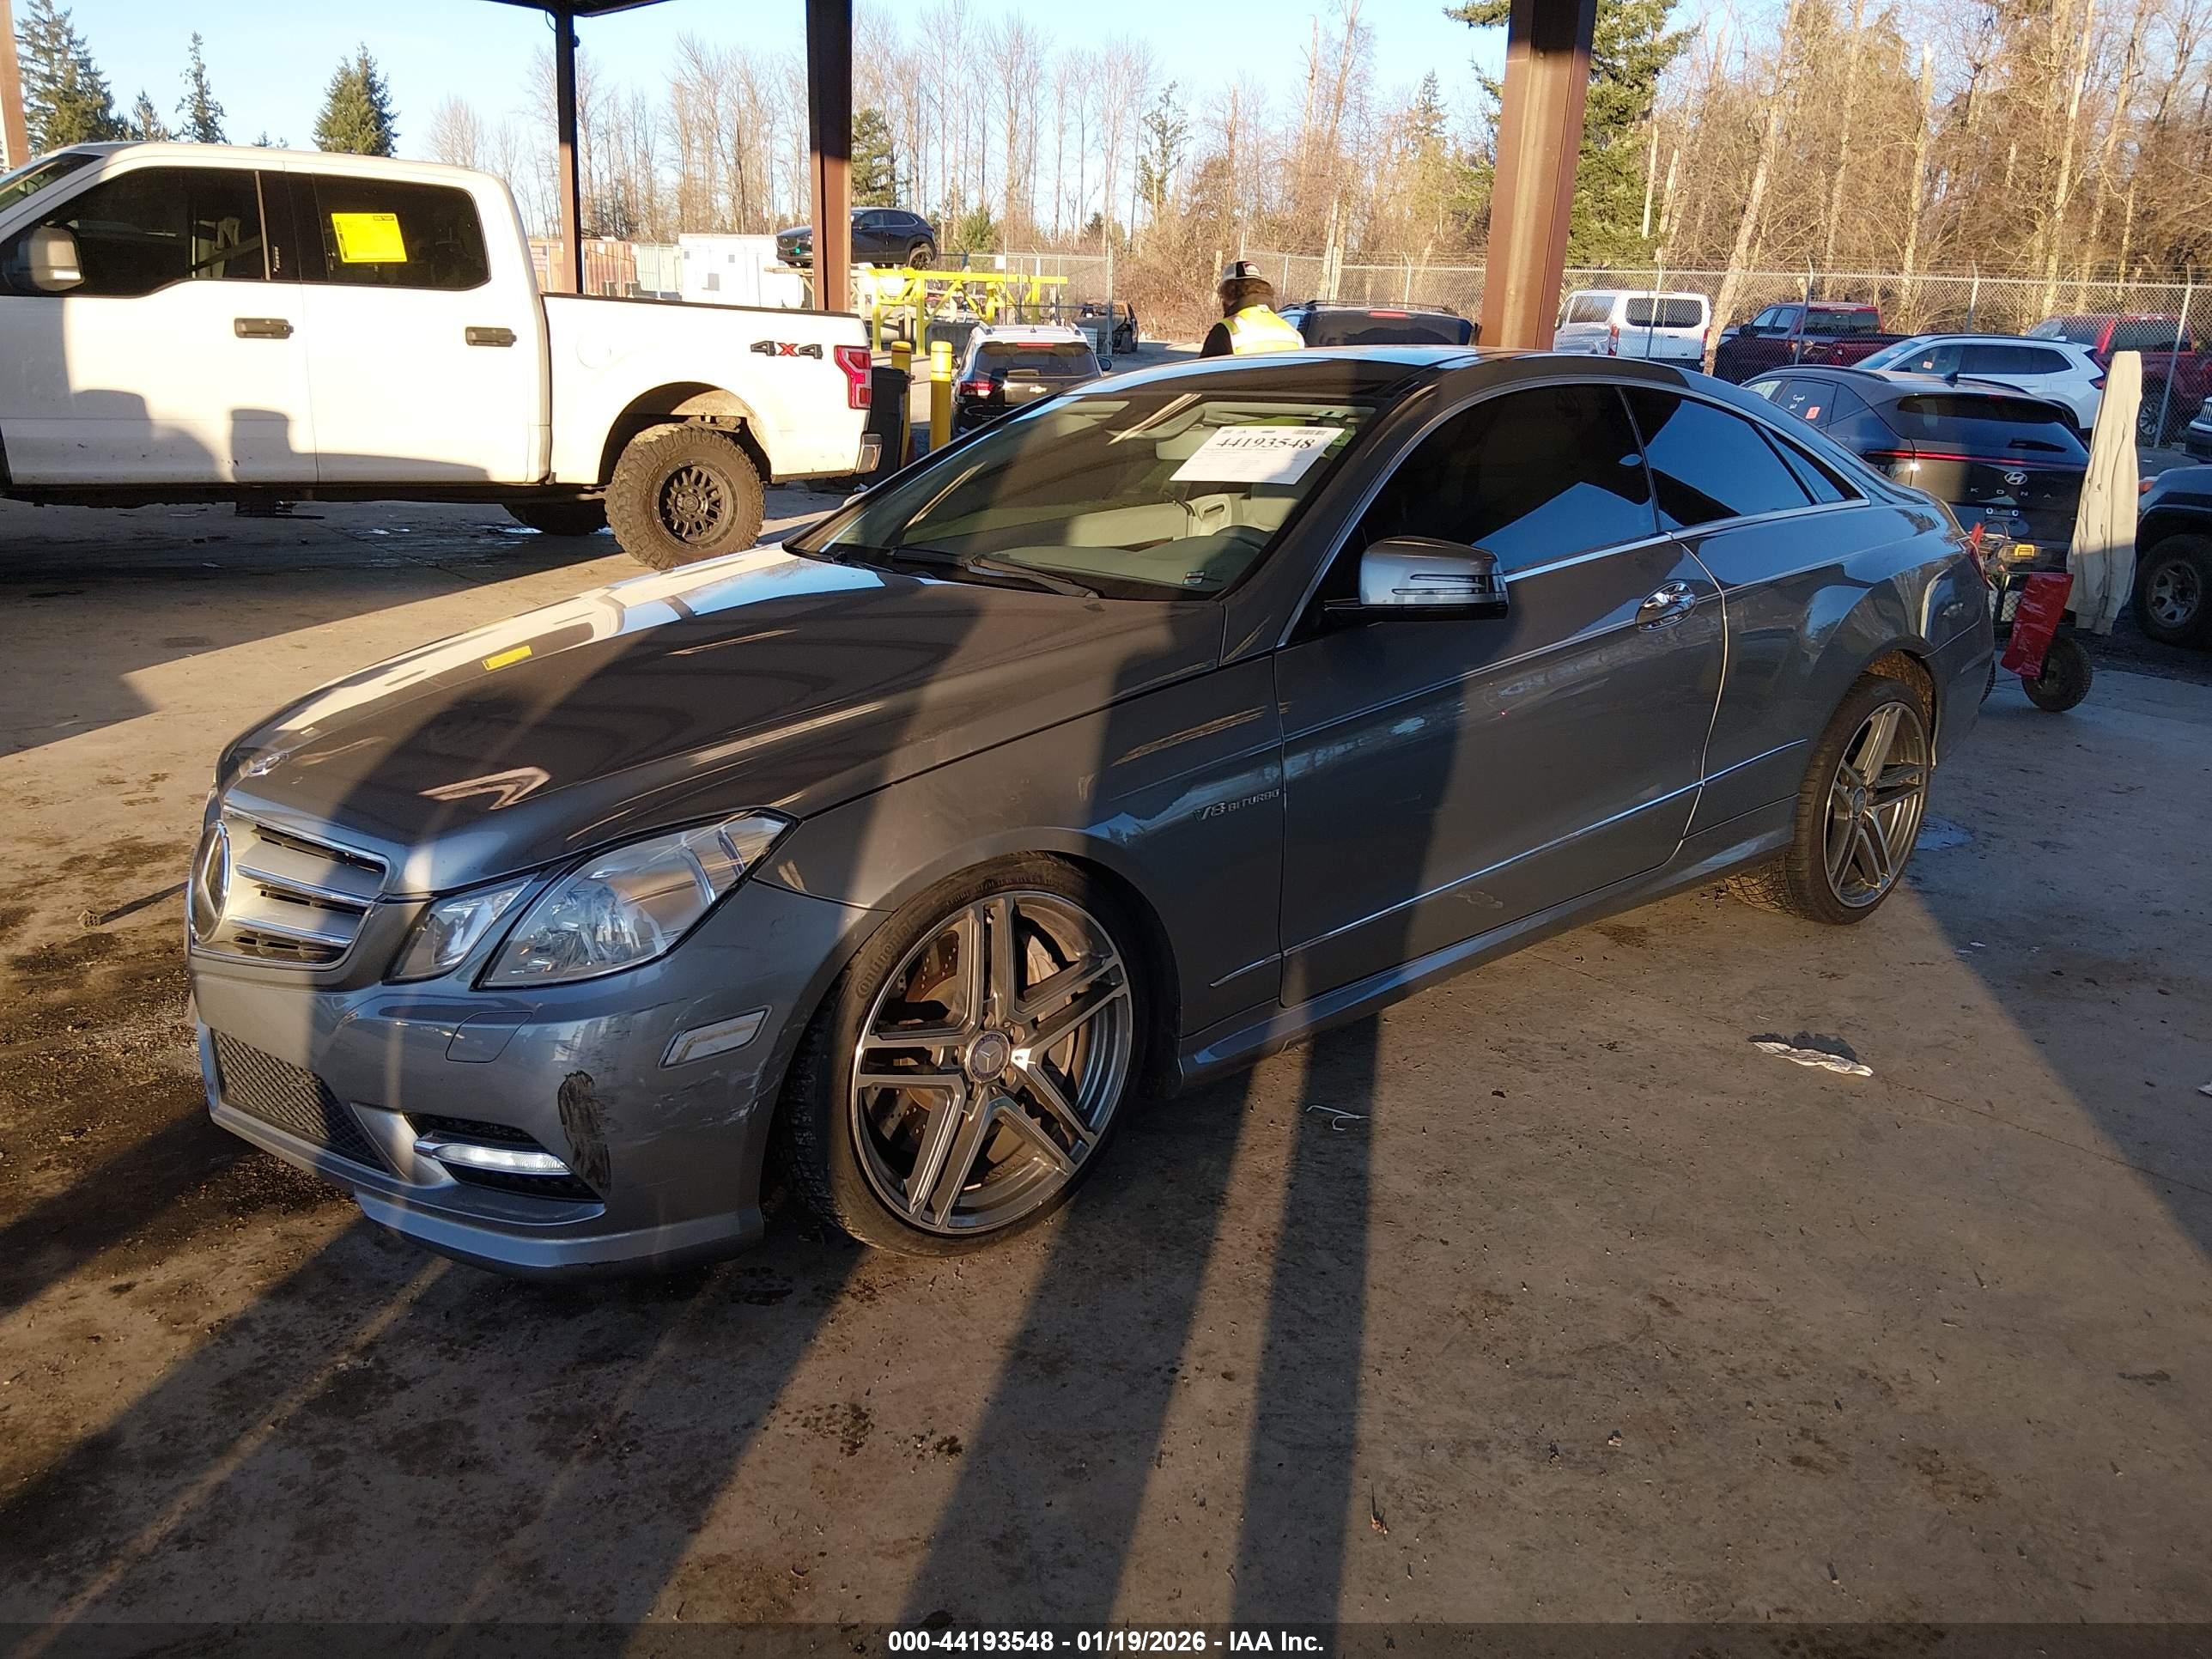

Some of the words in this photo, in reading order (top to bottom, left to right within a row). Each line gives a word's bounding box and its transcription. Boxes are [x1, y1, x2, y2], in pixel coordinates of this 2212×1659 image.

[1215, 437, 1316, 449] 44193548
[1969, 487, 2052, 500] KONA
[1194, 802, 1226, 821] V8
